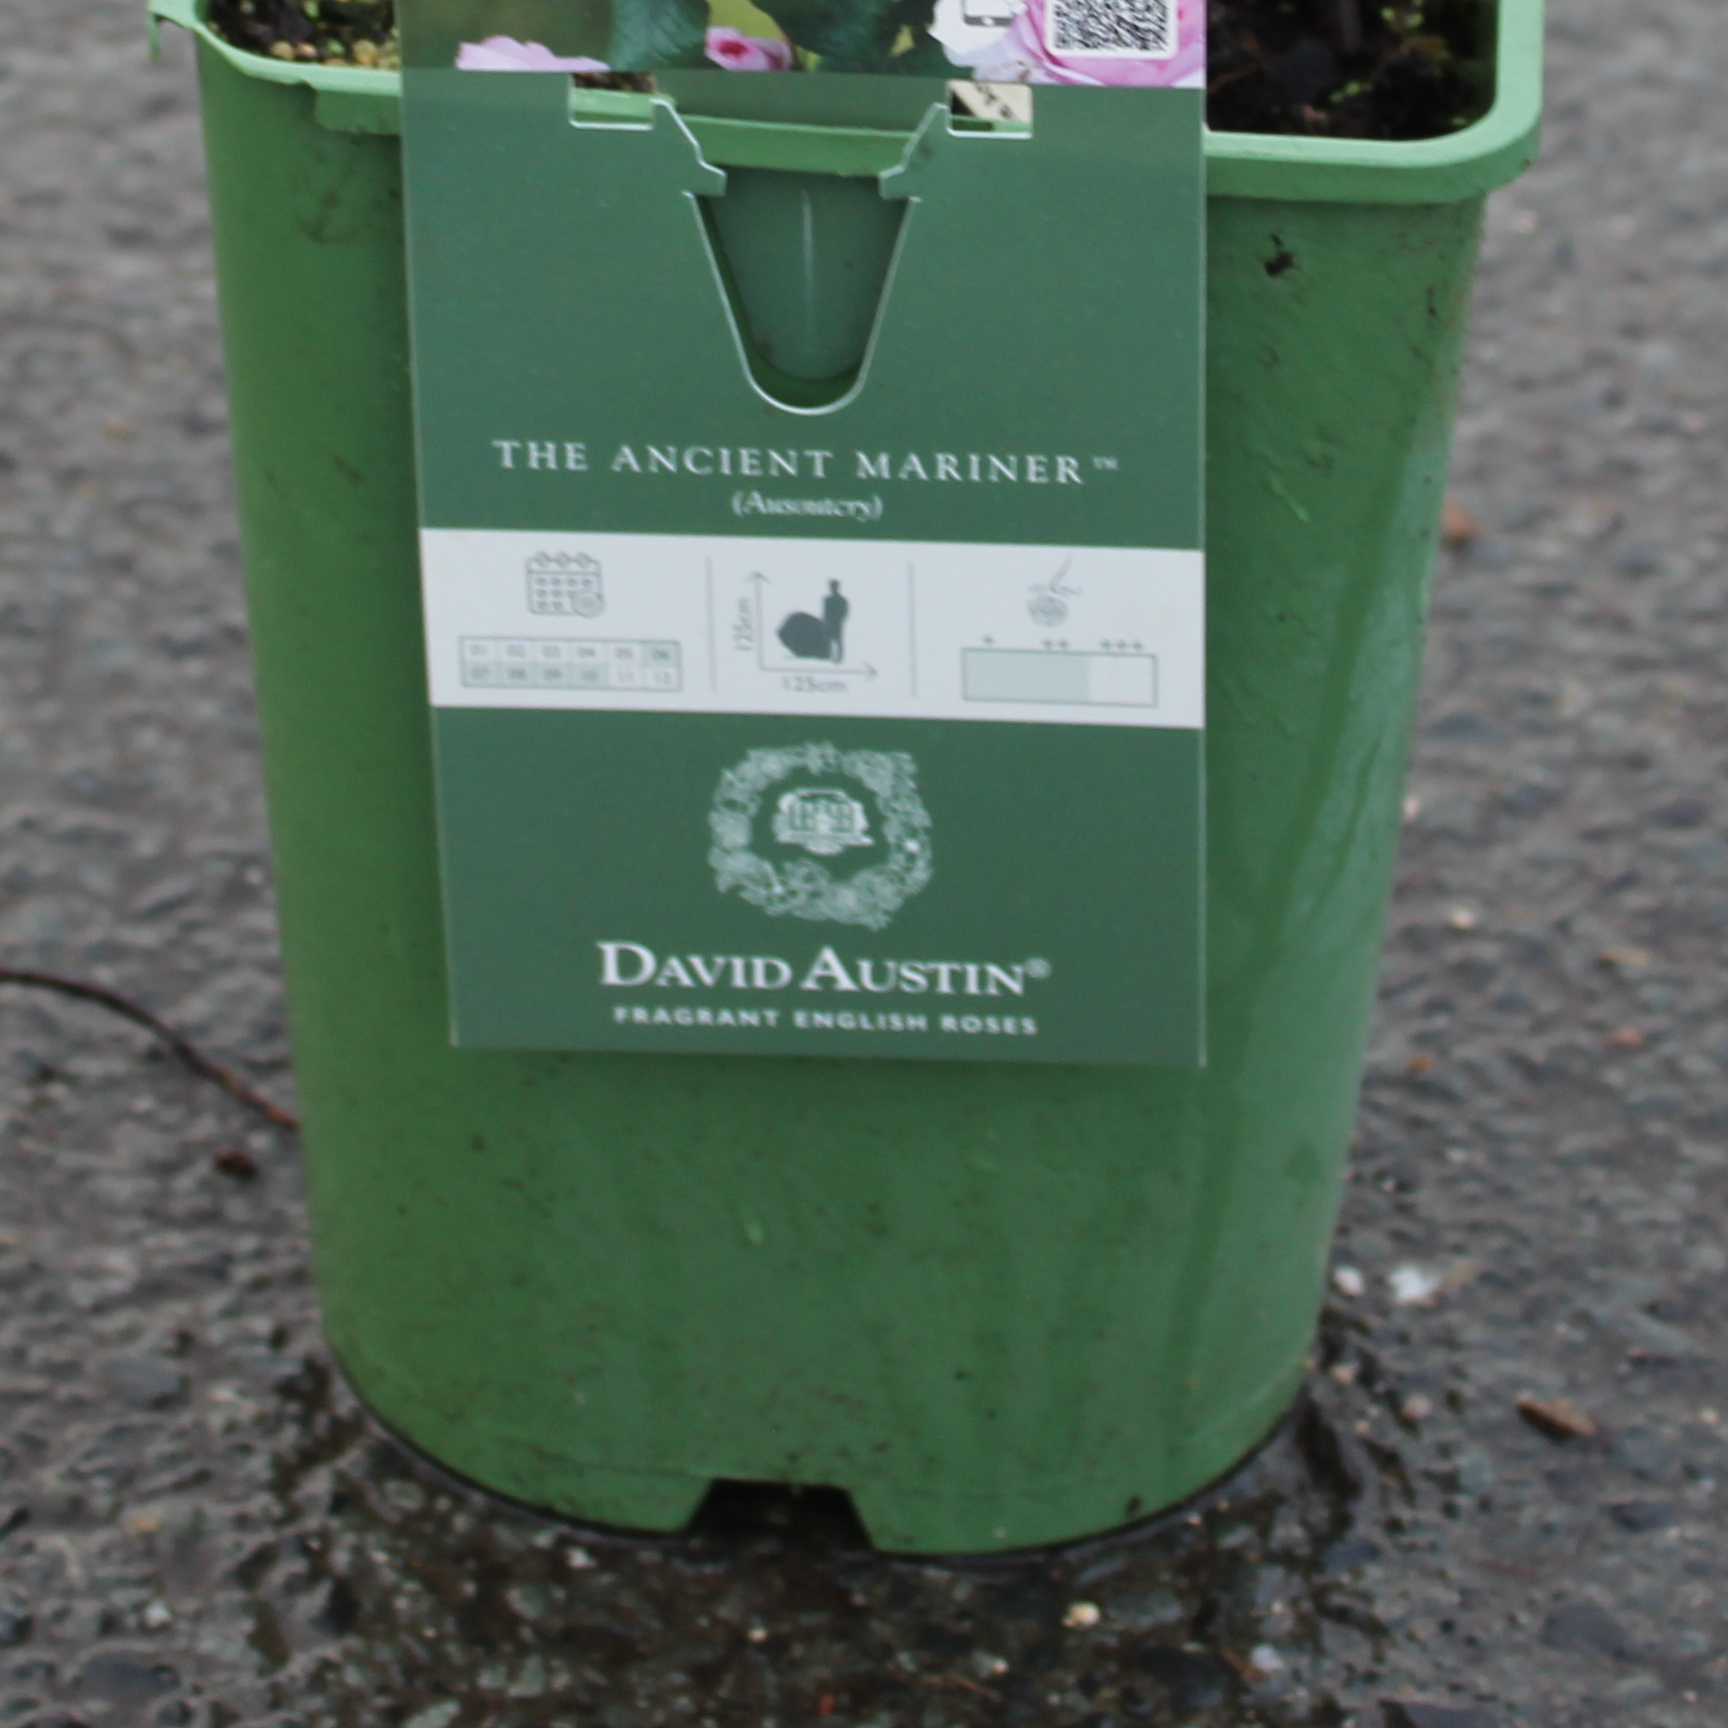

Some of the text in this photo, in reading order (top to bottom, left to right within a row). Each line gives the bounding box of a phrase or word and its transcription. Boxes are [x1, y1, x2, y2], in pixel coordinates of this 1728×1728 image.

[492, 440, 588, 471] THE
[611, 445, 833, 478] ANCIENT
[597, 940, 792, 989] DAVID
[614, 1006, 1038, 1036] FRAGRANT ENGLISH ROSES
